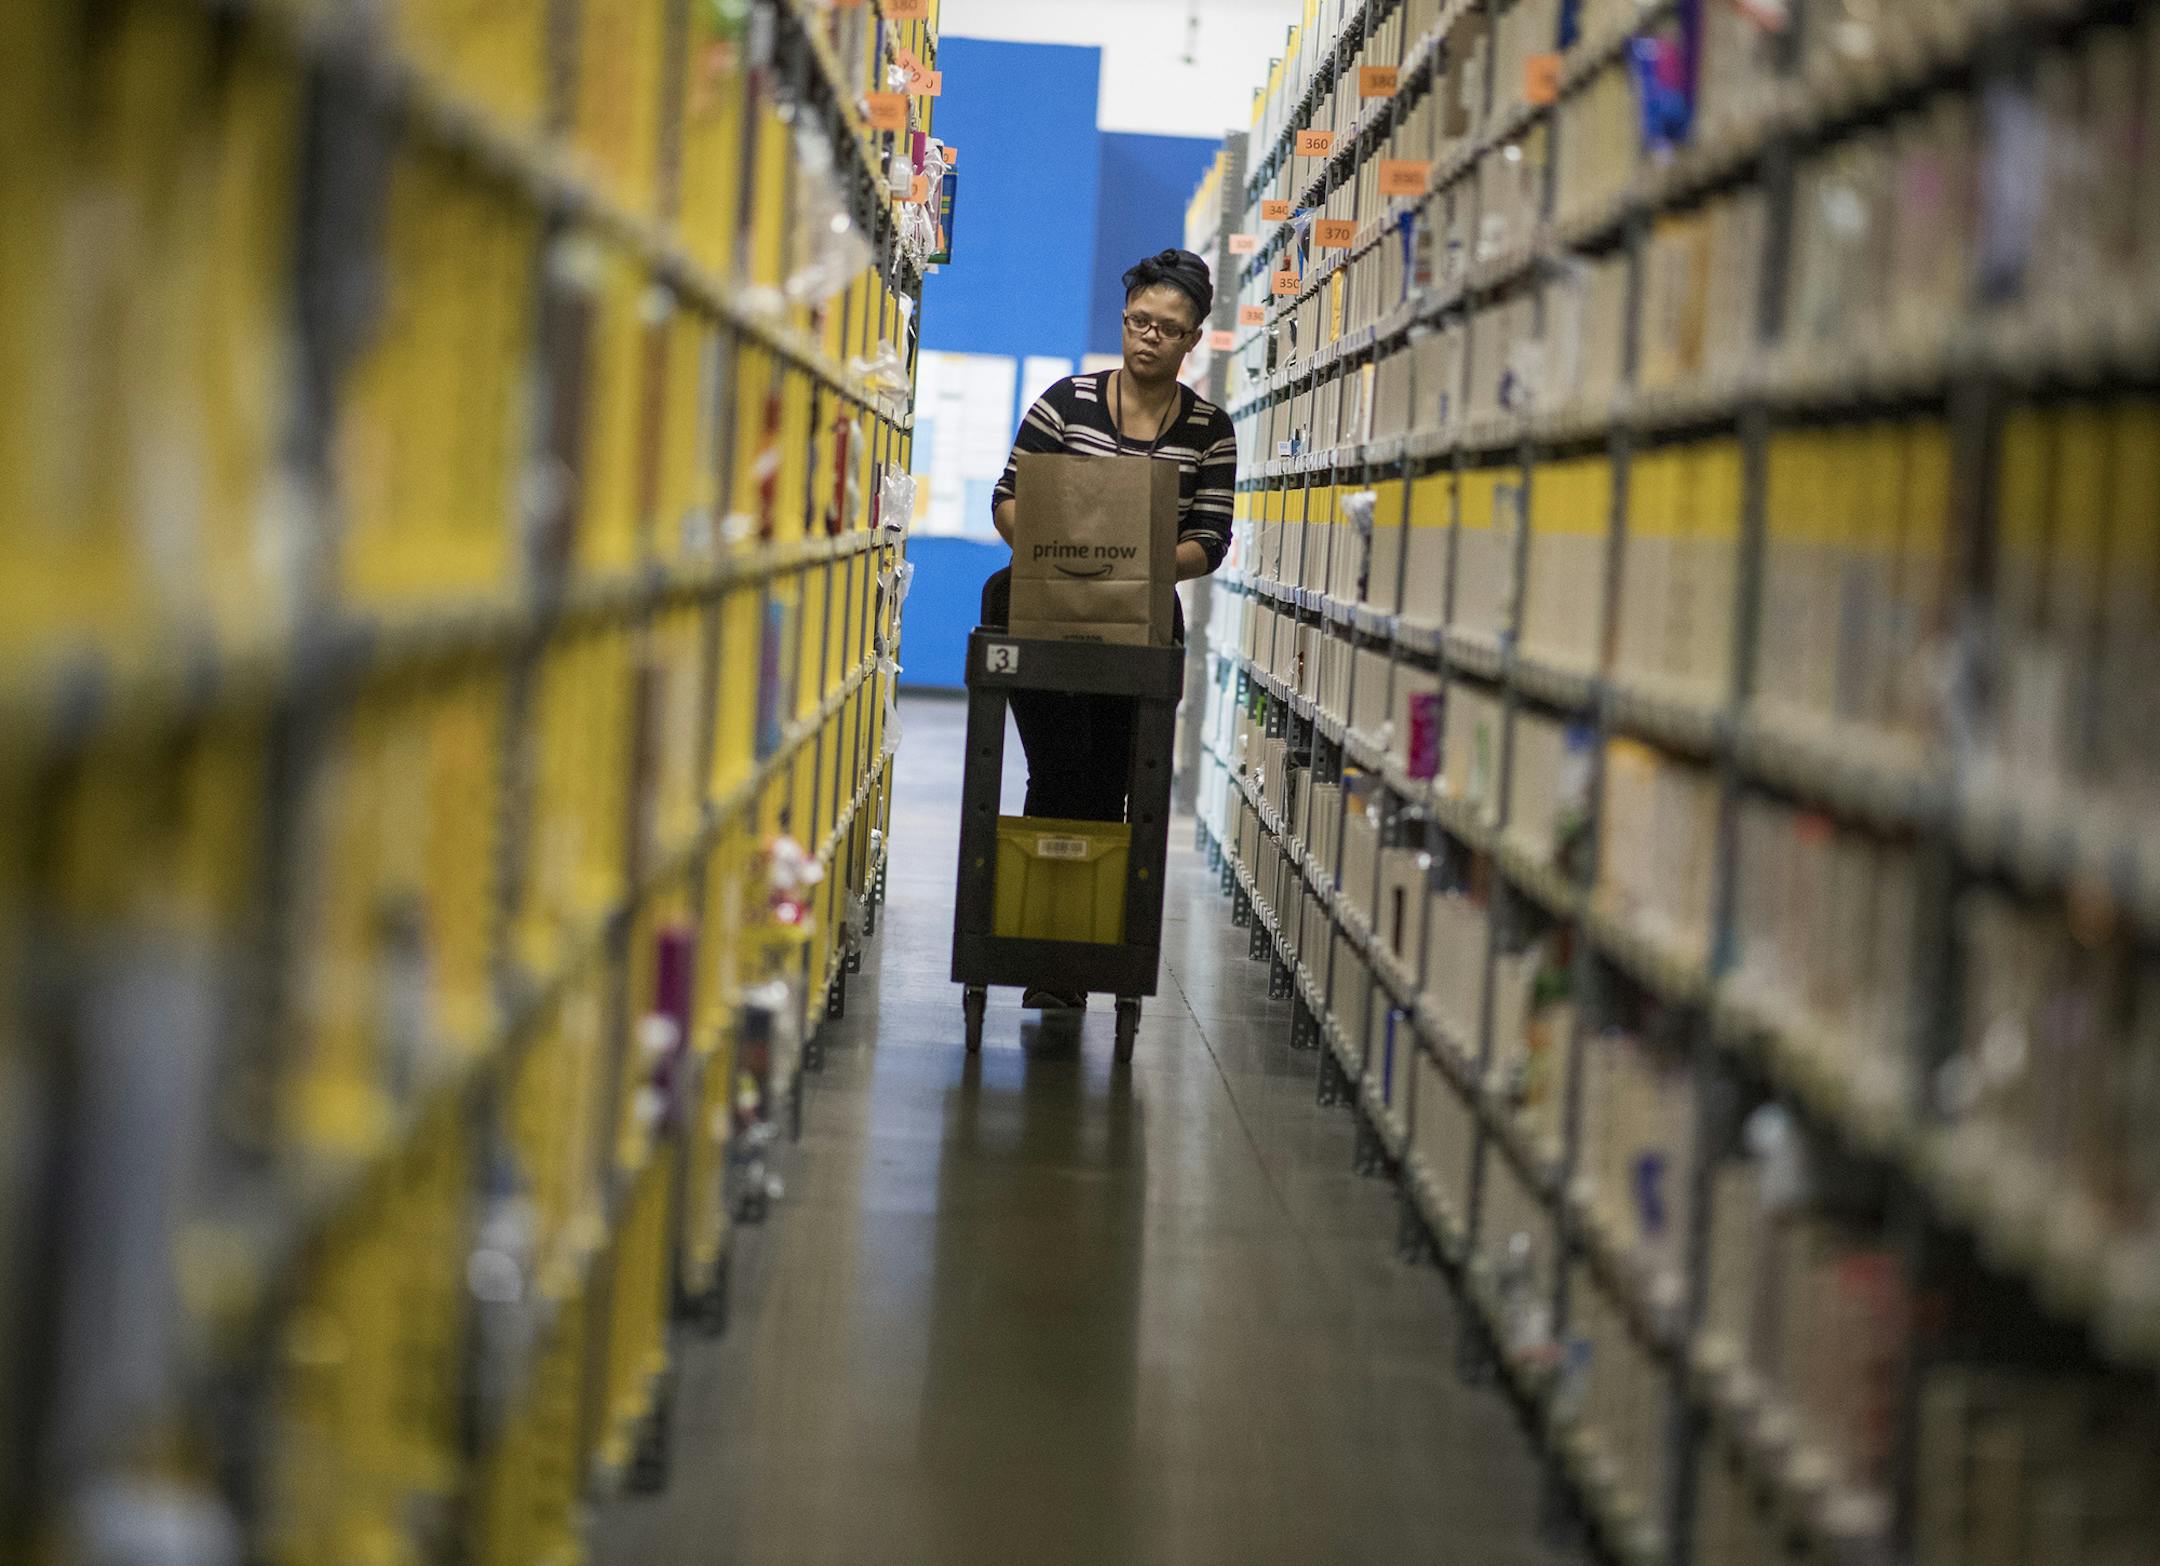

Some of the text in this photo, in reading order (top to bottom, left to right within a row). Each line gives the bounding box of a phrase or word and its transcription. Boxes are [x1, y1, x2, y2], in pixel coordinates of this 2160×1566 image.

[902, 59, 921, 83] 370
[1305, 138, 1329, 150] 360
[1269, 205, 1289, 216] 340
[1324, 227, 1350, 240] 370
[1279, 277, 1300, 289] 350
[1033, 540, 1137, 561] prime now
[995, 648, 1009, 670] 3
